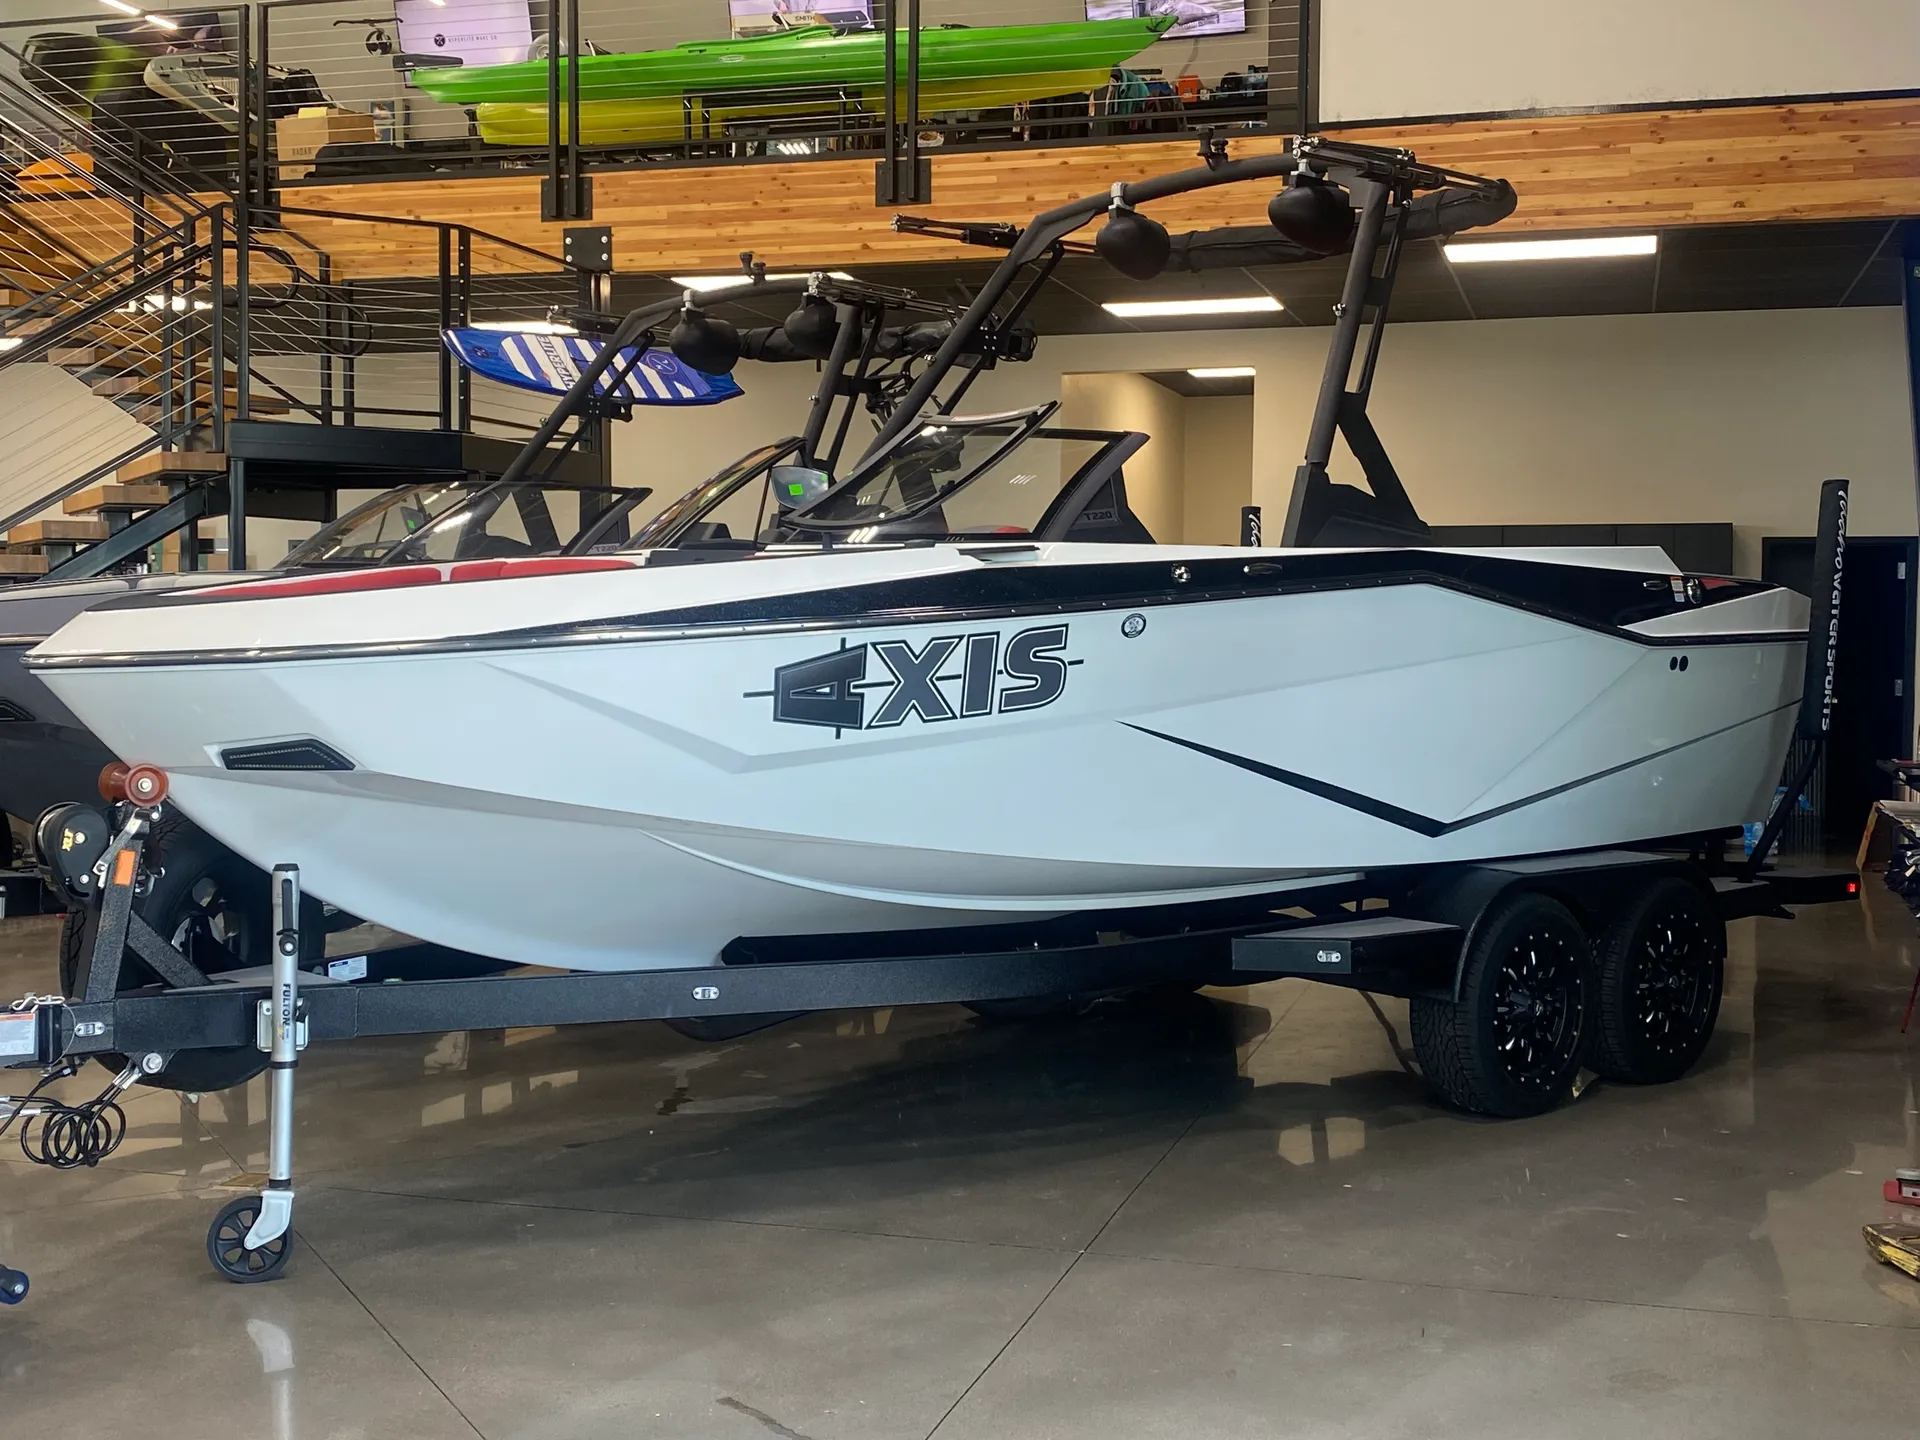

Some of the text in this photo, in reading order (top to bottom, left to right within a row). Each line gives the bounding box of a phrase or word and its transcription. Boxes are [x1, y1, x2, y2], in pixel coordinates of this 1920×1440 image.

[536, 335, 577, 389] HYPERLITE
[1083, 511, 1112, 520] T220
[773, 623, 1069, 730] AXIS
[1821, 648, 1836, 731] SPORTS
[282, 983, 291, 1026] FULTON
